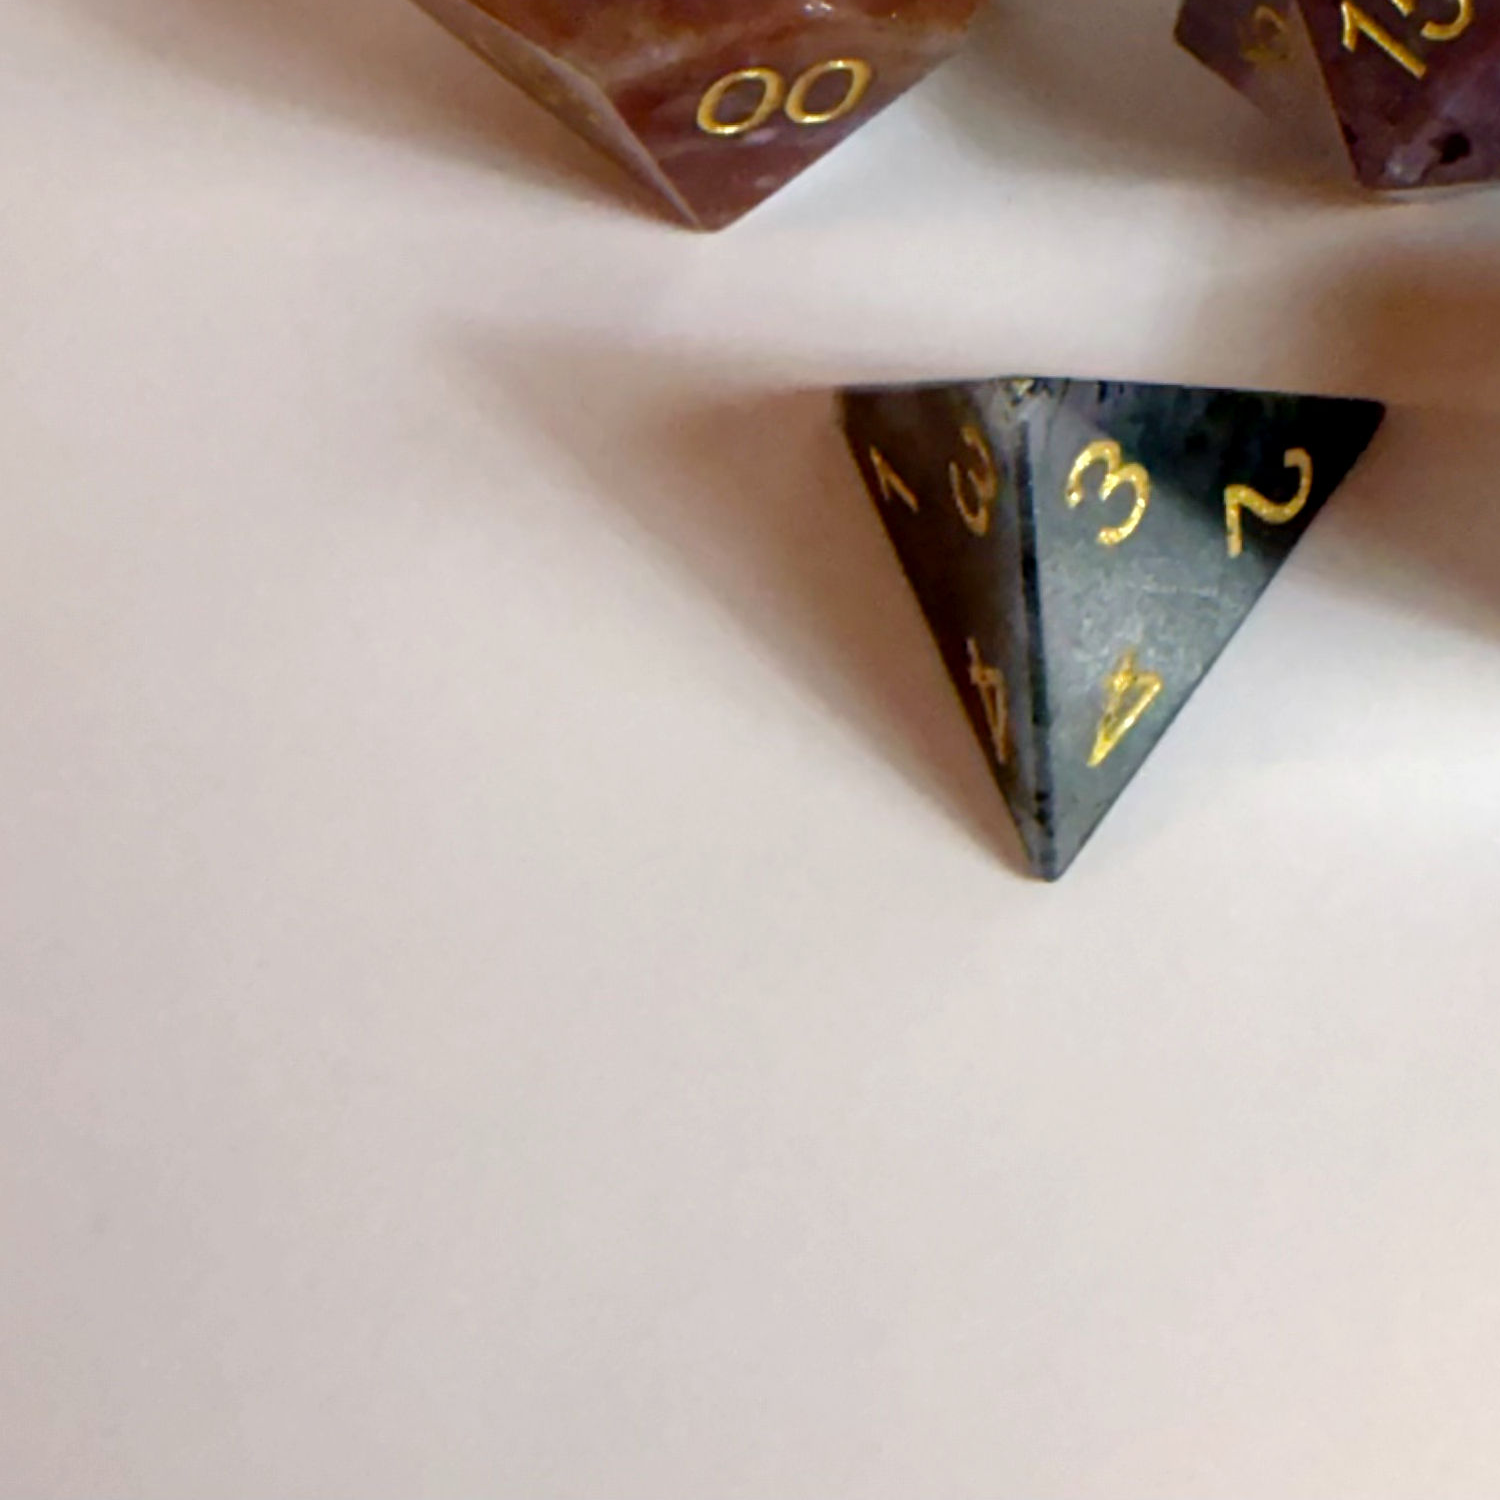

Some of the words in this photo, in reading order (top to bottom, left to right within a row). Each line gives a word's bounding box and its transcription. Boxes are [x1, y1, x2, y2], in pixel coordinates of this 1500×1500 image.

[697, 58, 871, 135] 00
[949, 424, 998, 537] 3
[1066, 439, 1151, 546] 3
[1224, 448, 1313, 558] 2
[1087, 650, 1162, 768] 4
